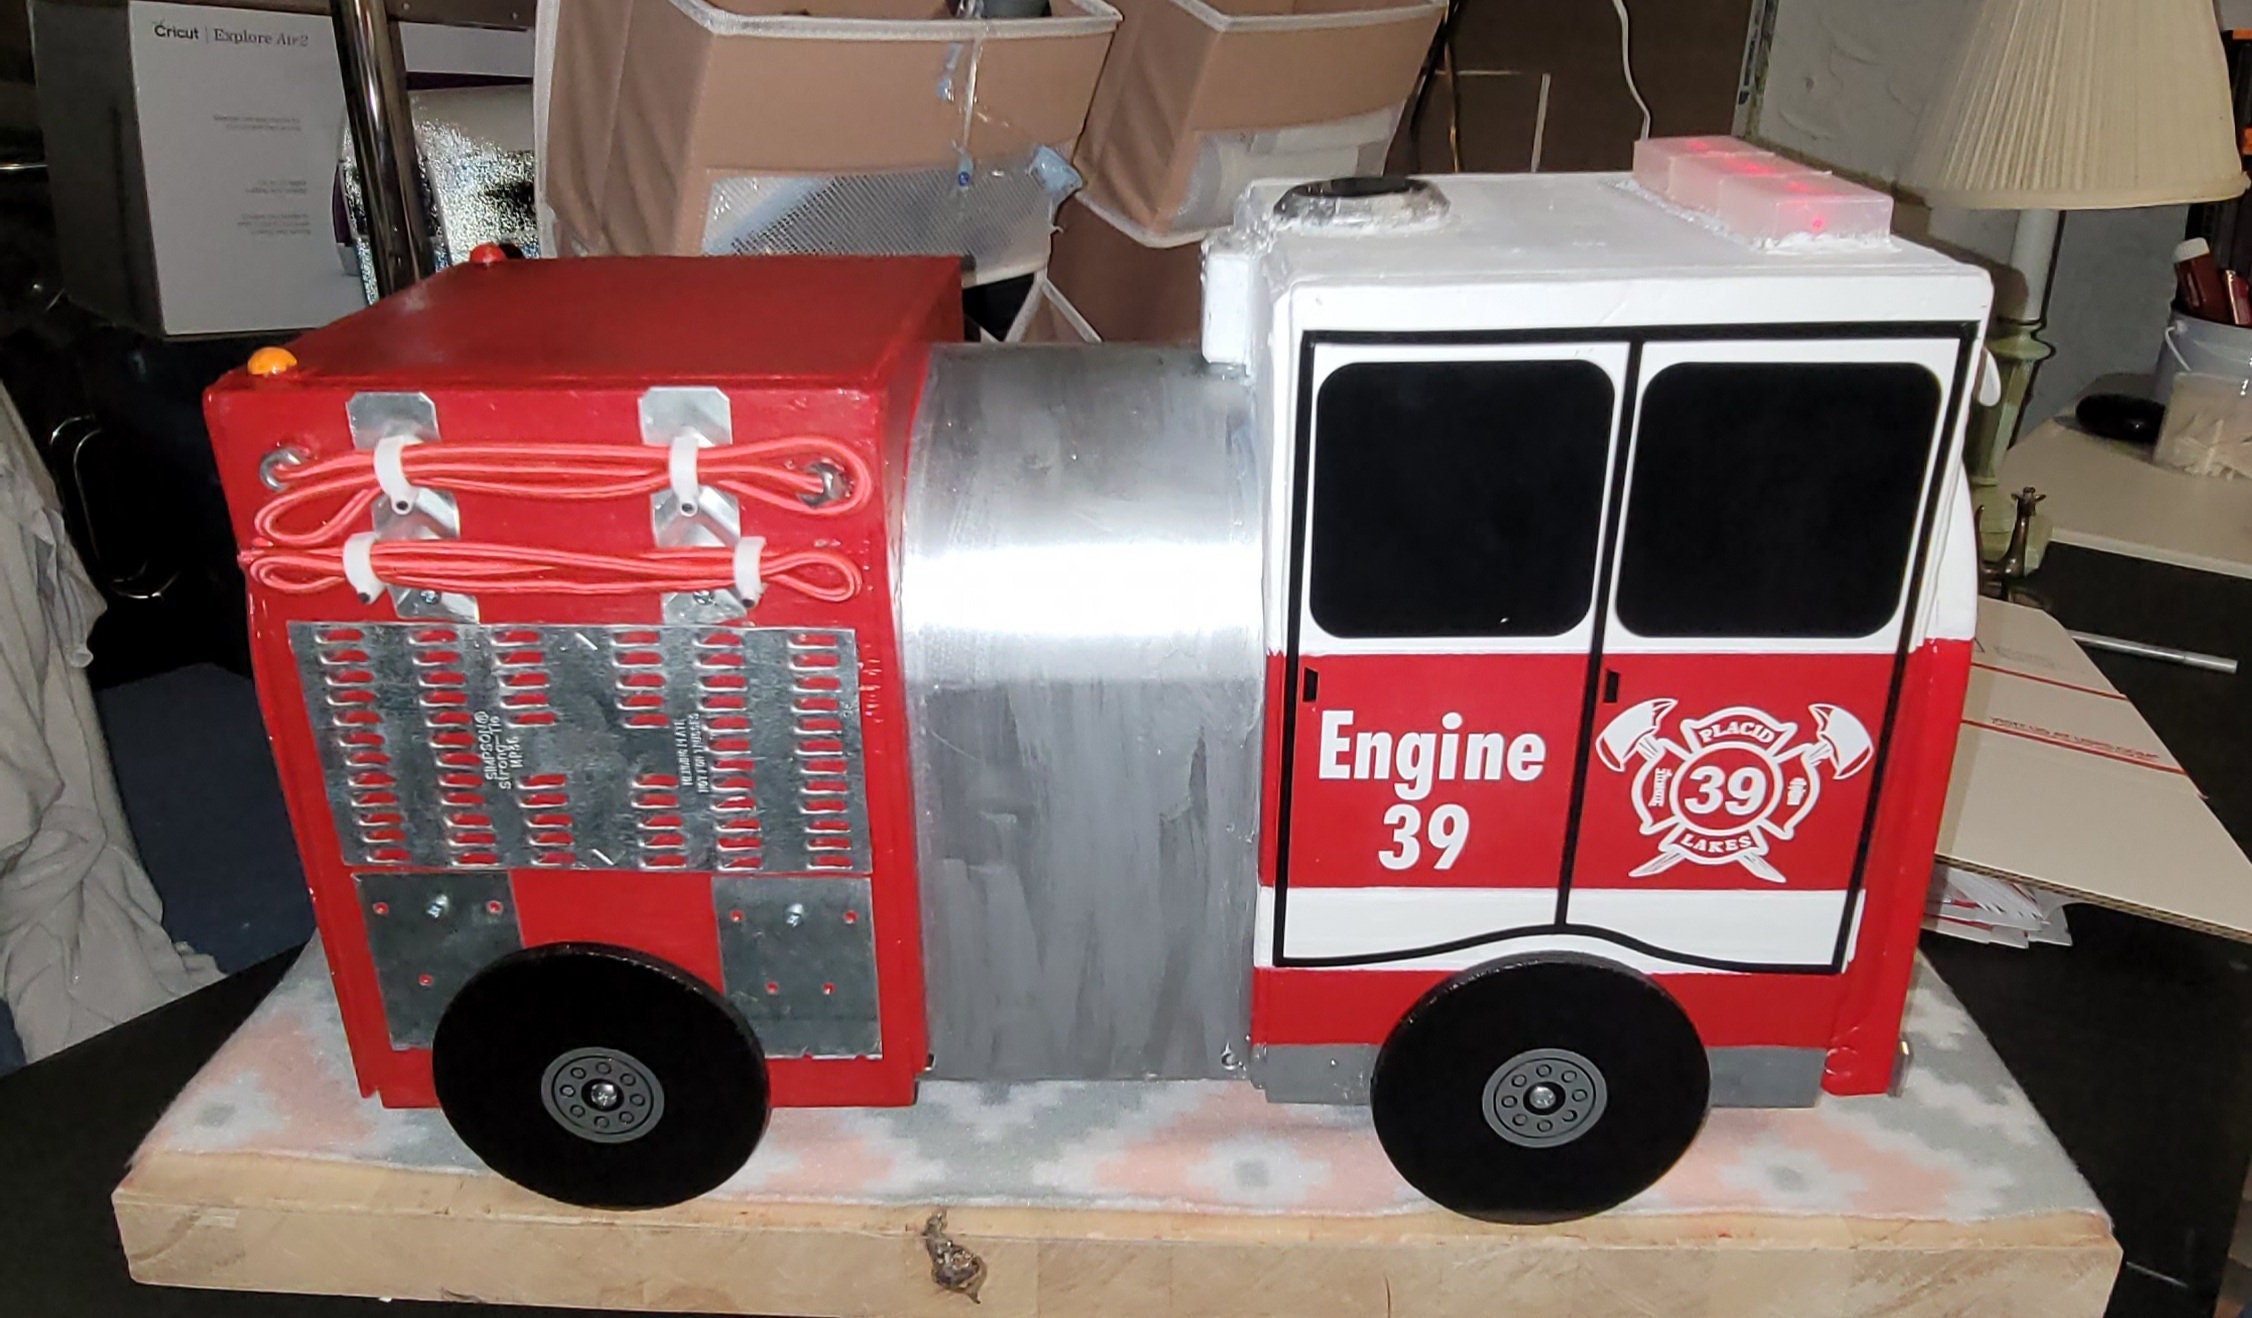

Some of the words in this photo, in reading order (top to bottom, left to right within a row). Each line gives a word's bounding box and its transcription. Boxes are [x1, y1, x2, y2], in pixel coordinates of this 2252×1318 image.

[153, 22, 199, 40] Cricut
[213, 28, 273, 45] Explore
[1698, 721, 1776, 743] PLACID
[1317, 709, 1546, 801] Engine
[1684, 765, 1768, 816] 39
[1378, 803, 1470, 870] 39
[1679, 833, 1752, 853] LAKES
